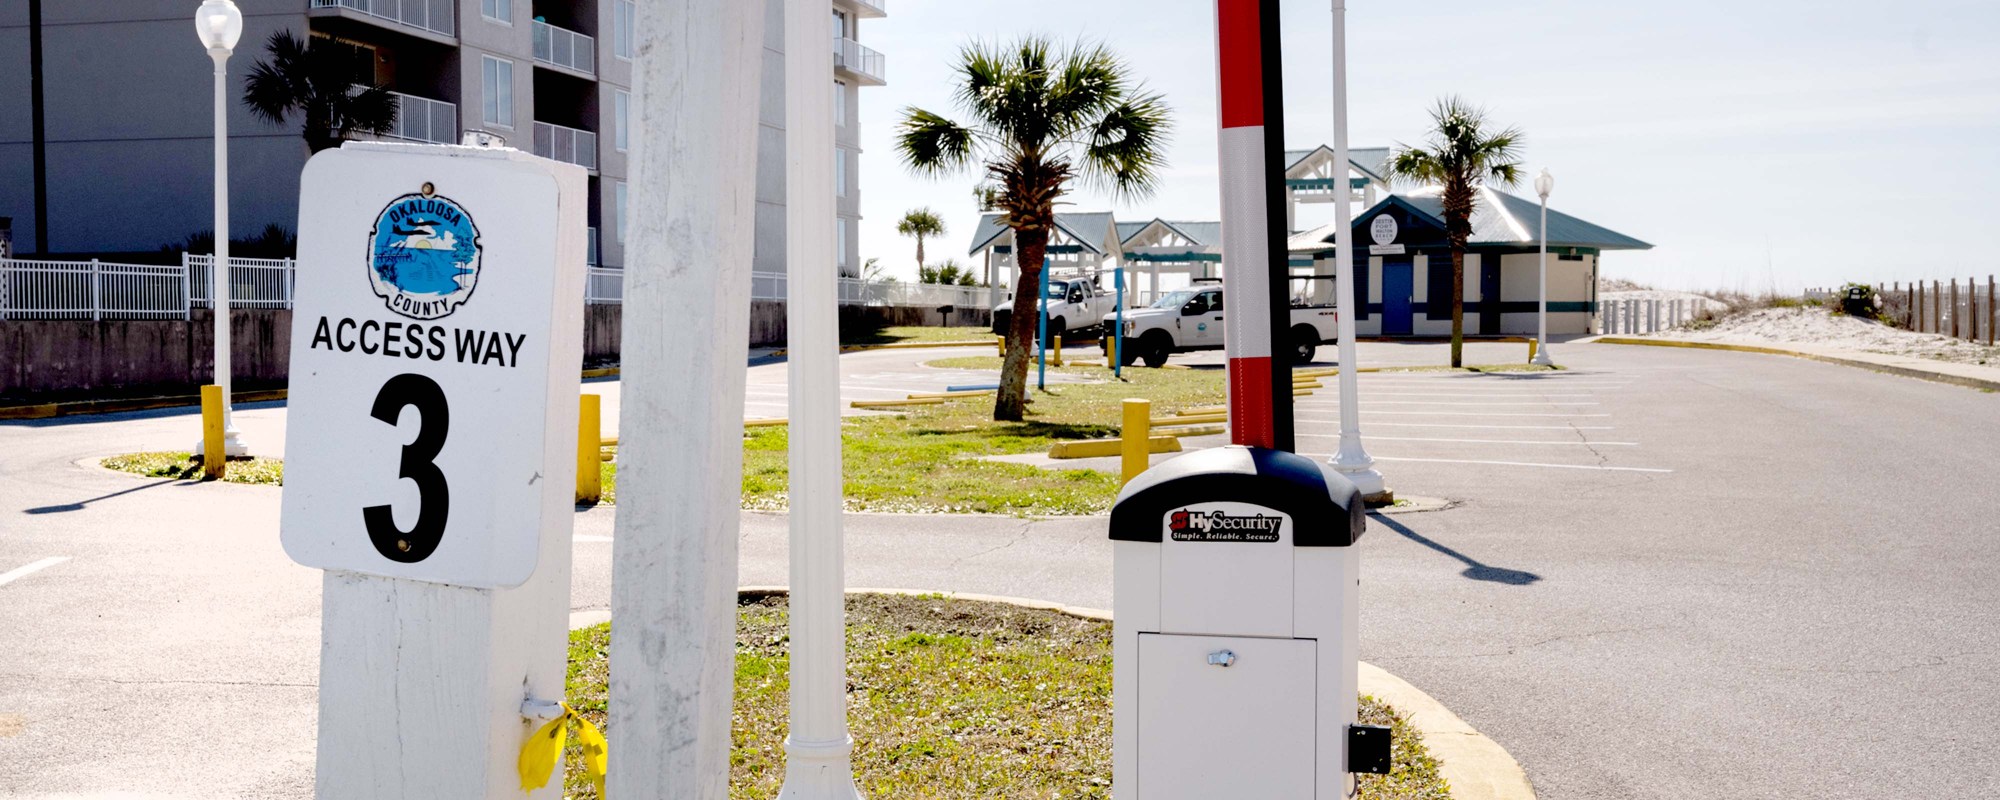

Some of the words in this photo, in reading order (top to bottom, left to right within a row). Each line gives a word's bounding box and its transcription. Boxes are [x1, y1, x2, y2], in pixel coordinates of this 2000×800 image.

[389, 200, 461, 227] OKALOOSA
[393, 294, 448, 315] COUNTY
[311, 316, 446, 361] ACCESS
[454, 328, 527, 368] WAY
[363, 373, 449, 563] 3
[1189, 512, 1279, 533] HySecurity
[1172, 532, 1203, 540] Simple.
[1206, 532, 1242, 540] Reliable.
